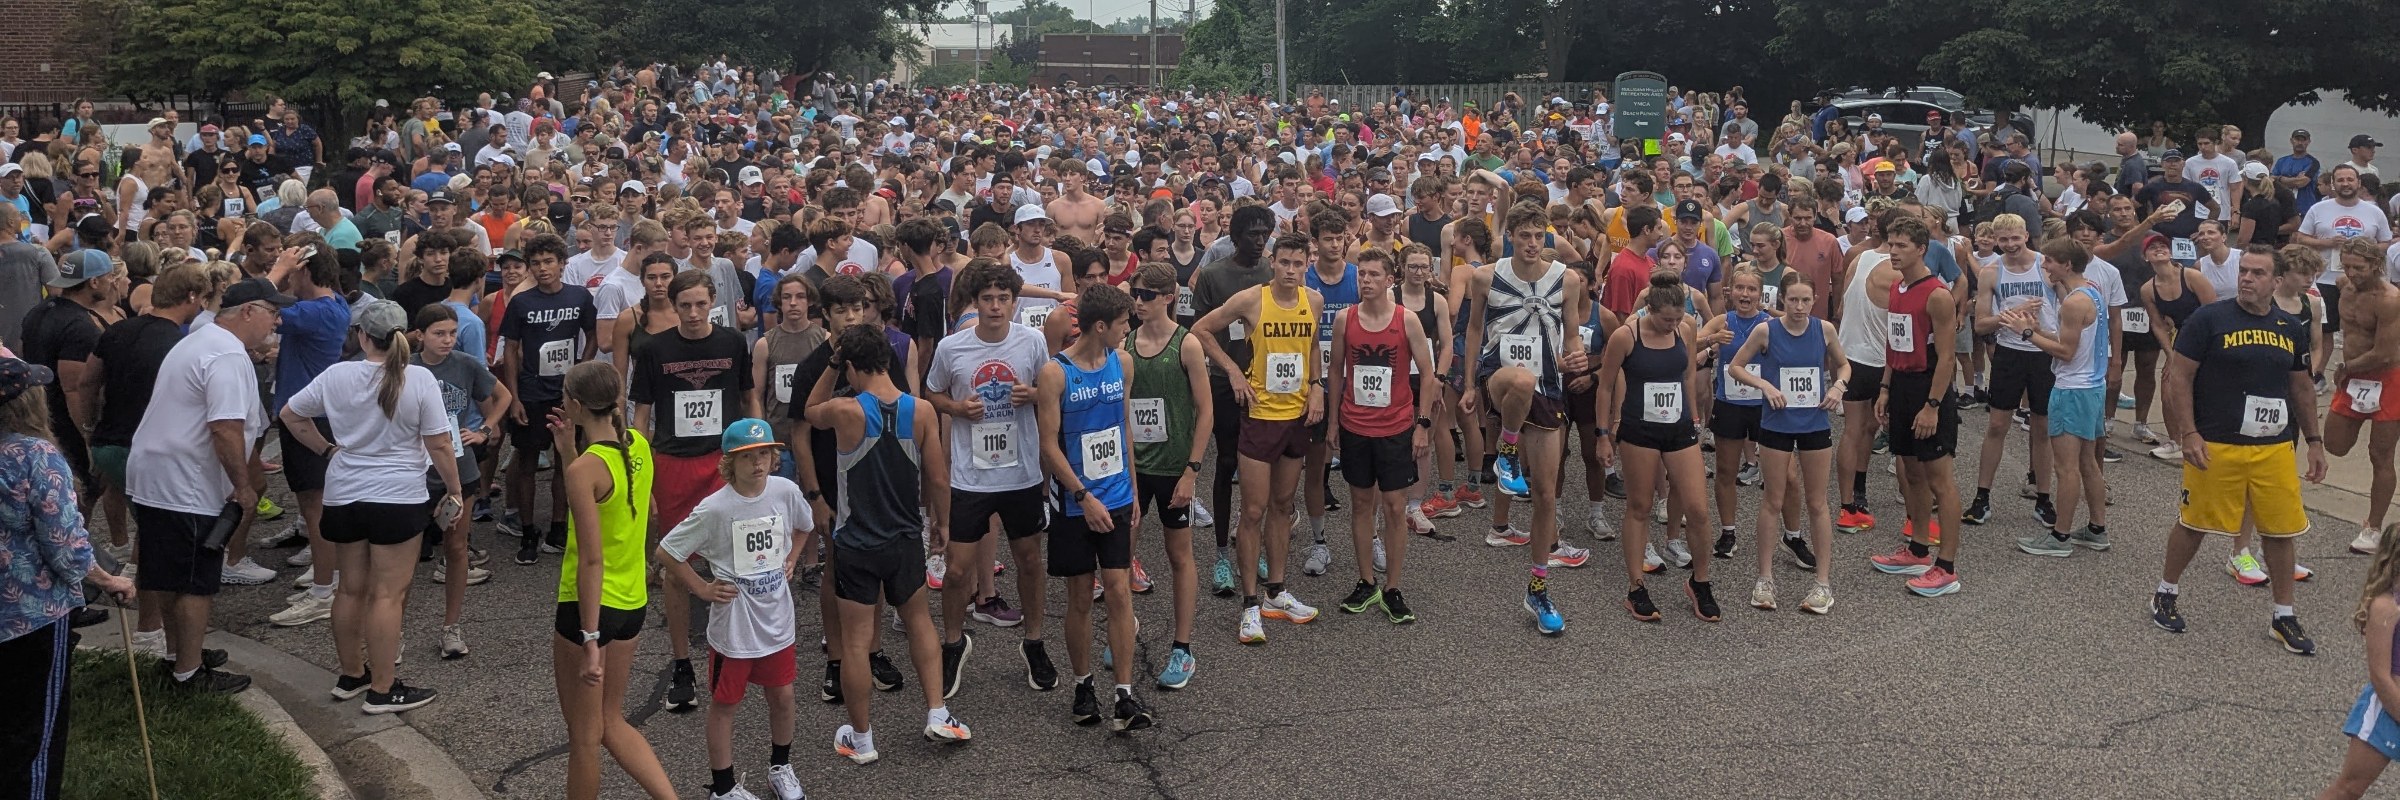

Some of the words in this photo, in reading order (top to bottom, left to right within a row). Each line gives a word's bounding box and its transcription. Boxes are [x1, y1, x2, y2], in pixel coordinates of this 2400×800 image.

[527, 307, 580, 323] SAILORS
[1029, 313, 1046, 327] 997
[2126, 311, 2144, 322] 1001
[1263, 322, 1312, 338] CALVIN
[1891, 321, 1905, 337] 1168
[2223, 328, 2294, 354] MICHIGAN
[546, 348, 568, 363] 1458
[1510, 344, 1532, 361] 988
[1276, 362, 1295, 378] 993
[1070, 387, 1098, 402] elite
[1100, 378, 1123, 395] feet
[1362, 375, 1382, 391] 992
[1789, 376, 1812, 392] 1138
[1653, 392, 1676, 407] 1017
[2357, 387, 2371, 401] 77
[683, 401, 713, 419] 1237
[987, 403, 1012, 411] GUARD
[996, 409, 1014, 417] RUN
[2255, 406, 2280, 424] 1218
[1134, 408, 1159, 426] 1225
[983, 434, 1007, 452] 1116
[1090, 439, 1115, 462] 1309
[746, 528, 773, 553] 695
[734, 577, 757, 587] OAST
[758, 572, 783, 586] GUARD
[748, 586, 768, 595] USA
